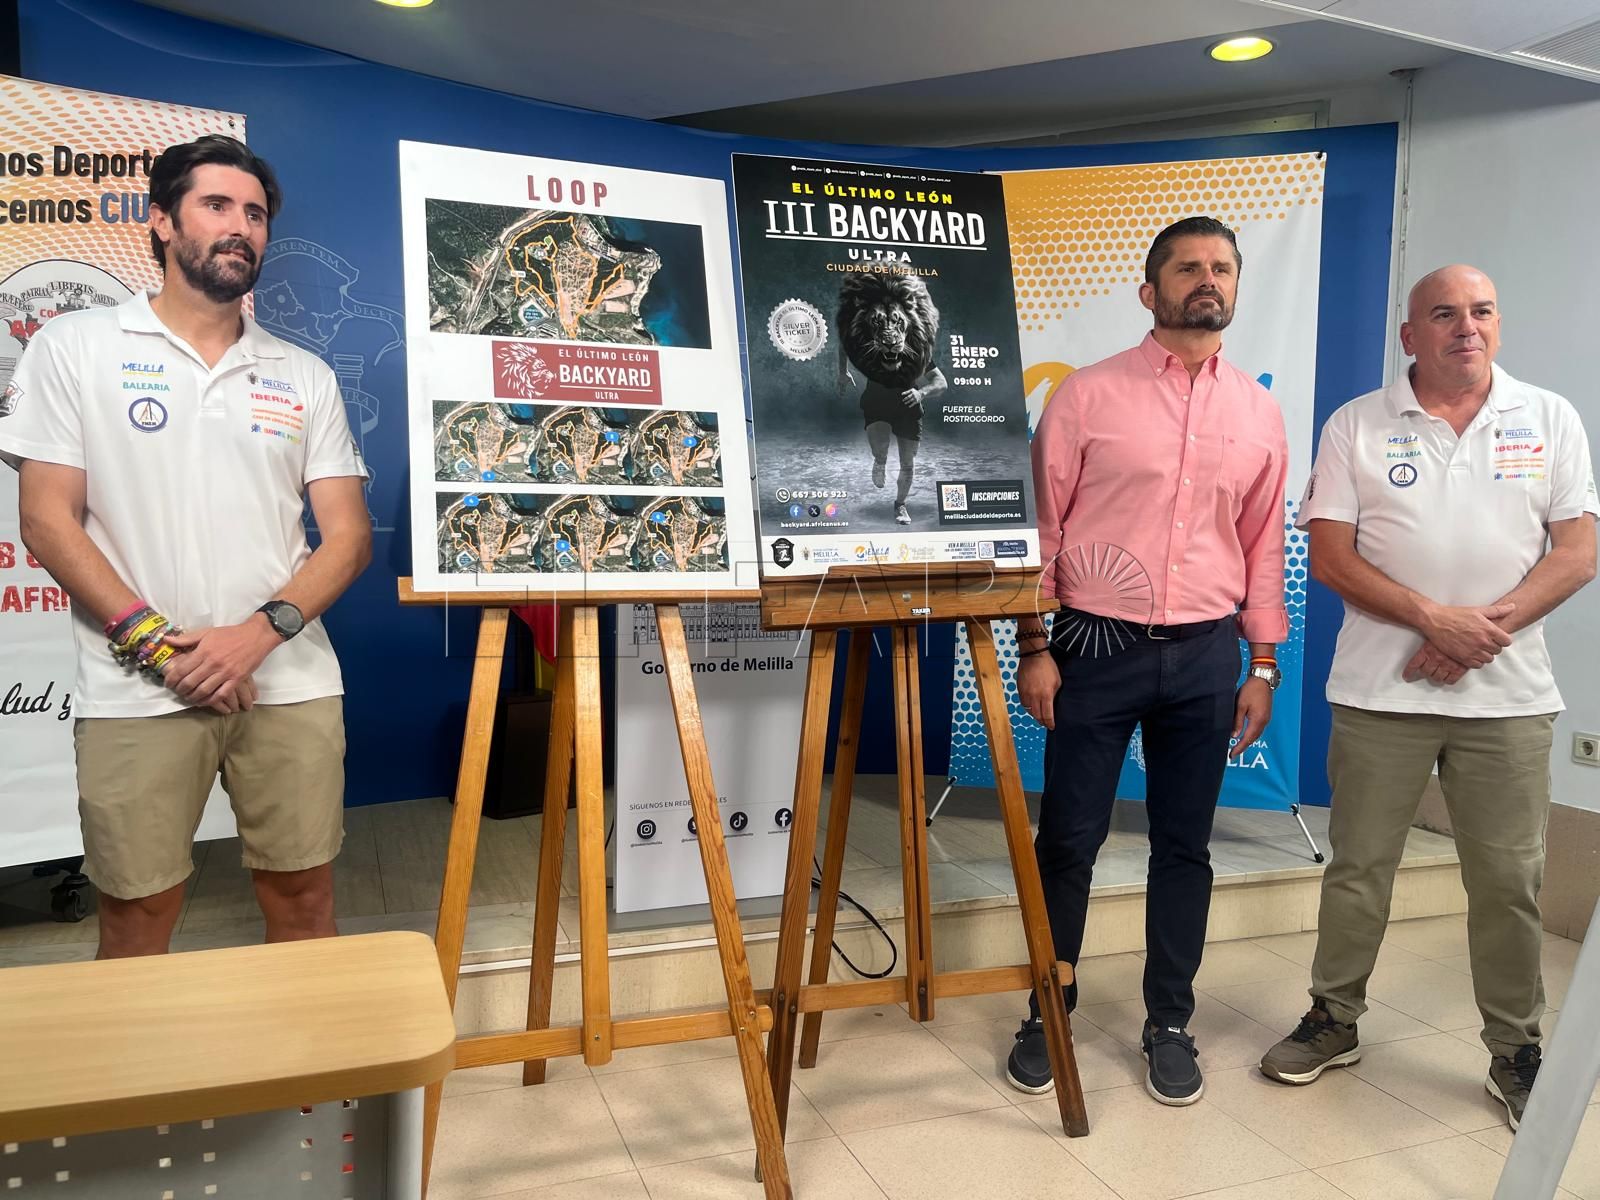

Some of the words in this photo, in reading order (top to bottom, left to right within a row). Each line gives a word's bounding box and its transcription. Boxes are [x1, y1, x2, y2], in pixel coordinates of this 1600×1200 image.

[53, 145, 158, 184] Deport
[527, 174, 608, 207] LOOP
[792, 182, 814, 195] EL
[824, 182, 896, 201] ÚLTIMO
[906, 190, 953, 205] LEÓN
[100, 192, 149, 224] CIU
[763, 200, 818, 235] III
[829, 202, 987, 246] BACKYARD
[848, 248, 912, 263] ULTRA
[826, 263, 870, 273] CIUDAD
[874, 266, 889, 274] DE
[892, 266, 939, 277] MELILLA
[264, 240, 340, 269] ARENTEM
[353, 304, 394, 321] DECET
[782, 322, 810, 330] SILVER
[950, 334, 964, 346] 31
[558, 348, 572, 358] EL
[576, 348, 617, 361] ÚLTIMO
[622, 351, 650, 362] LEÓN
[951, 346, 999, 358] ENERO
[122, 362, 164, 373] MELILLA
[952, 358, 986, 368] 2026
[559, 364, 651, 387] BACKYARD
[954, 378, 982, 386] 09:00
[984, 378, 992, 386] H
[122, 382, 171, 392] BALEARIA
[250, 392, 292, 405] IBERIA
[342, 390, 369, 407] TRA
[595, 392, 620, 400] ULTRA
[944, 415, 1006, 423] ROSTROGORDO
[1386, 450, 1422, 458] BALEARIA
[1495, 444, 1531, 452] IBERIA
[792, 490, 808, 498] 667
[972, 491, 1020, 502] INSCRIPCIONES
[0, 585, 69, 613] AFRI
[642, 660, 716, 675] Gorno
[720, 658, 740, 672] de
[744, 656, 794, 672] Melilla
[0, 681, 55, 715] lud
[1226, 748, 1269, 770] LLA
